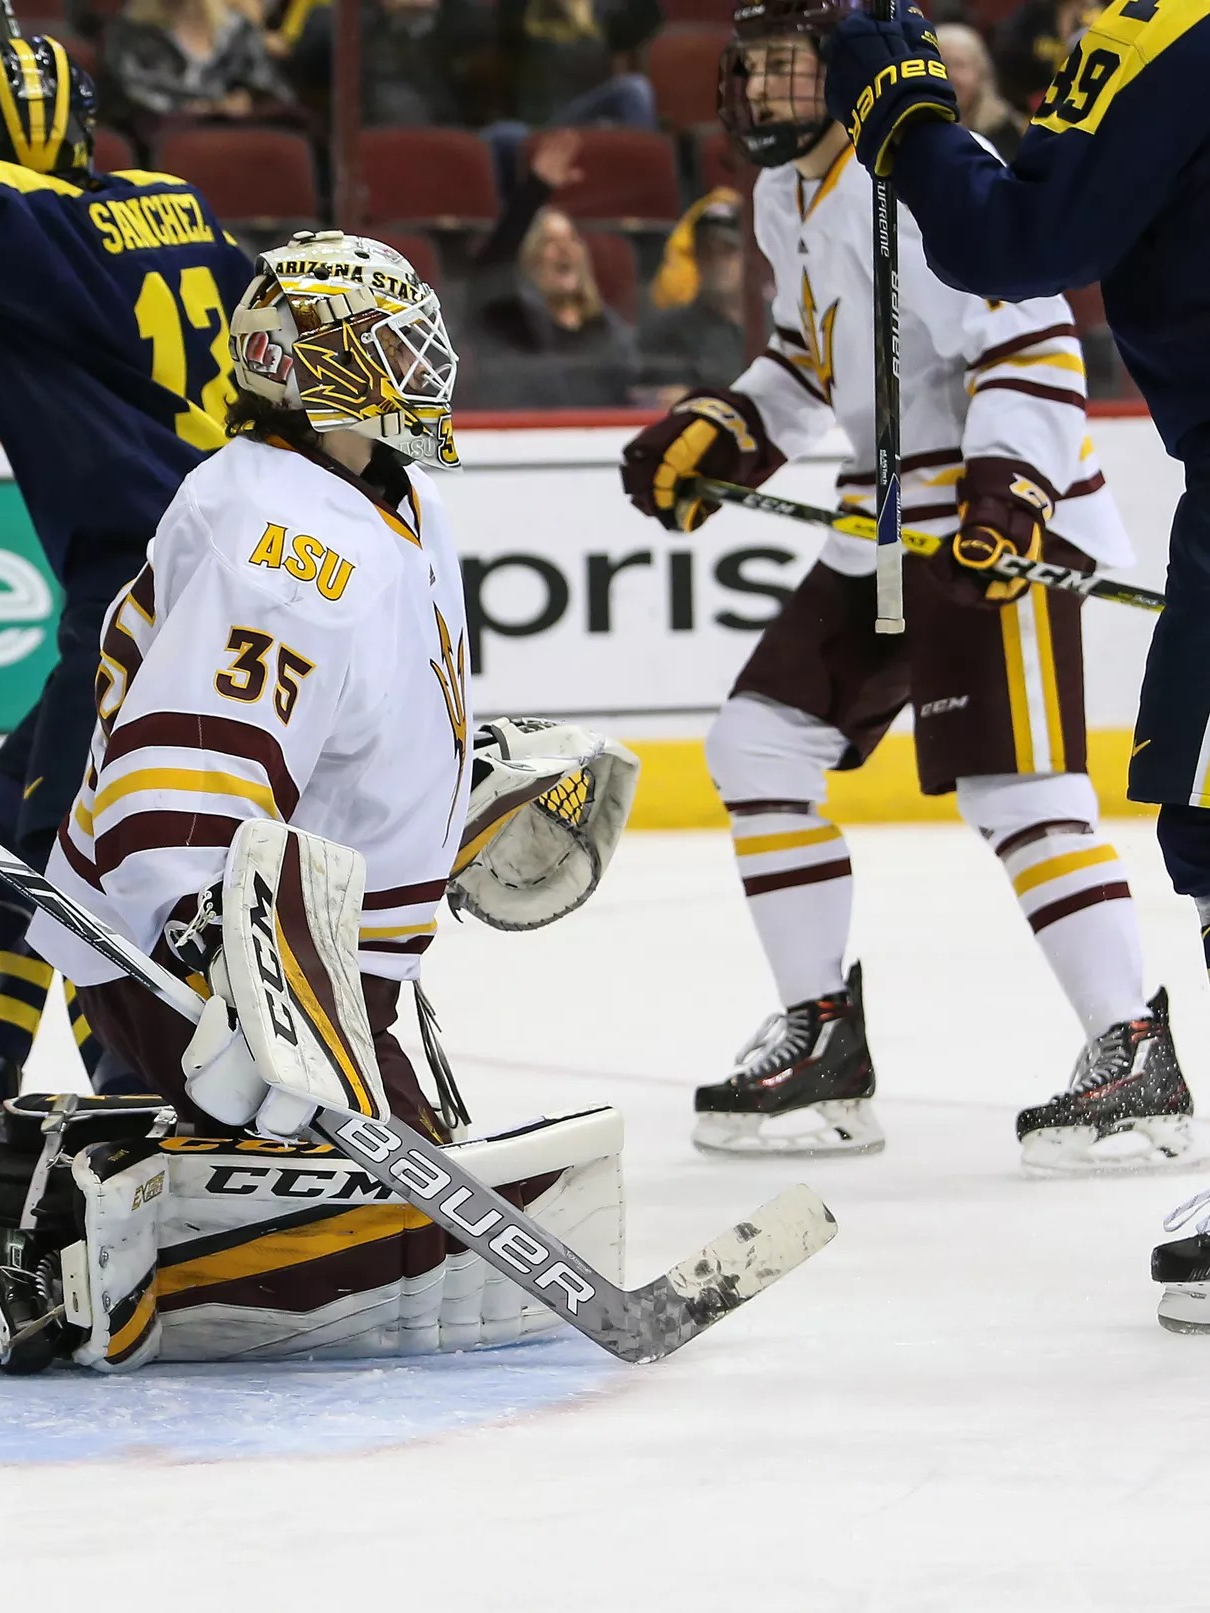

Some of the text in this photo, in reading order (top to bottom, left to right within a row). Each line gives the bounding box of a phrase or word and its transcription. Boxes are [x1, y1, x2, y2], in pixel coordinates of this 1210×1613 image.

[89, 193, 215, 255] SANCHEZ
[248, 521, 357, 601] ASU
[993, 552, 1095, 595] CCM
[212, 625, 317, 728] 35
[920, 694, 970, 719] CCM
[250, 870, 298, 1047] CCM
